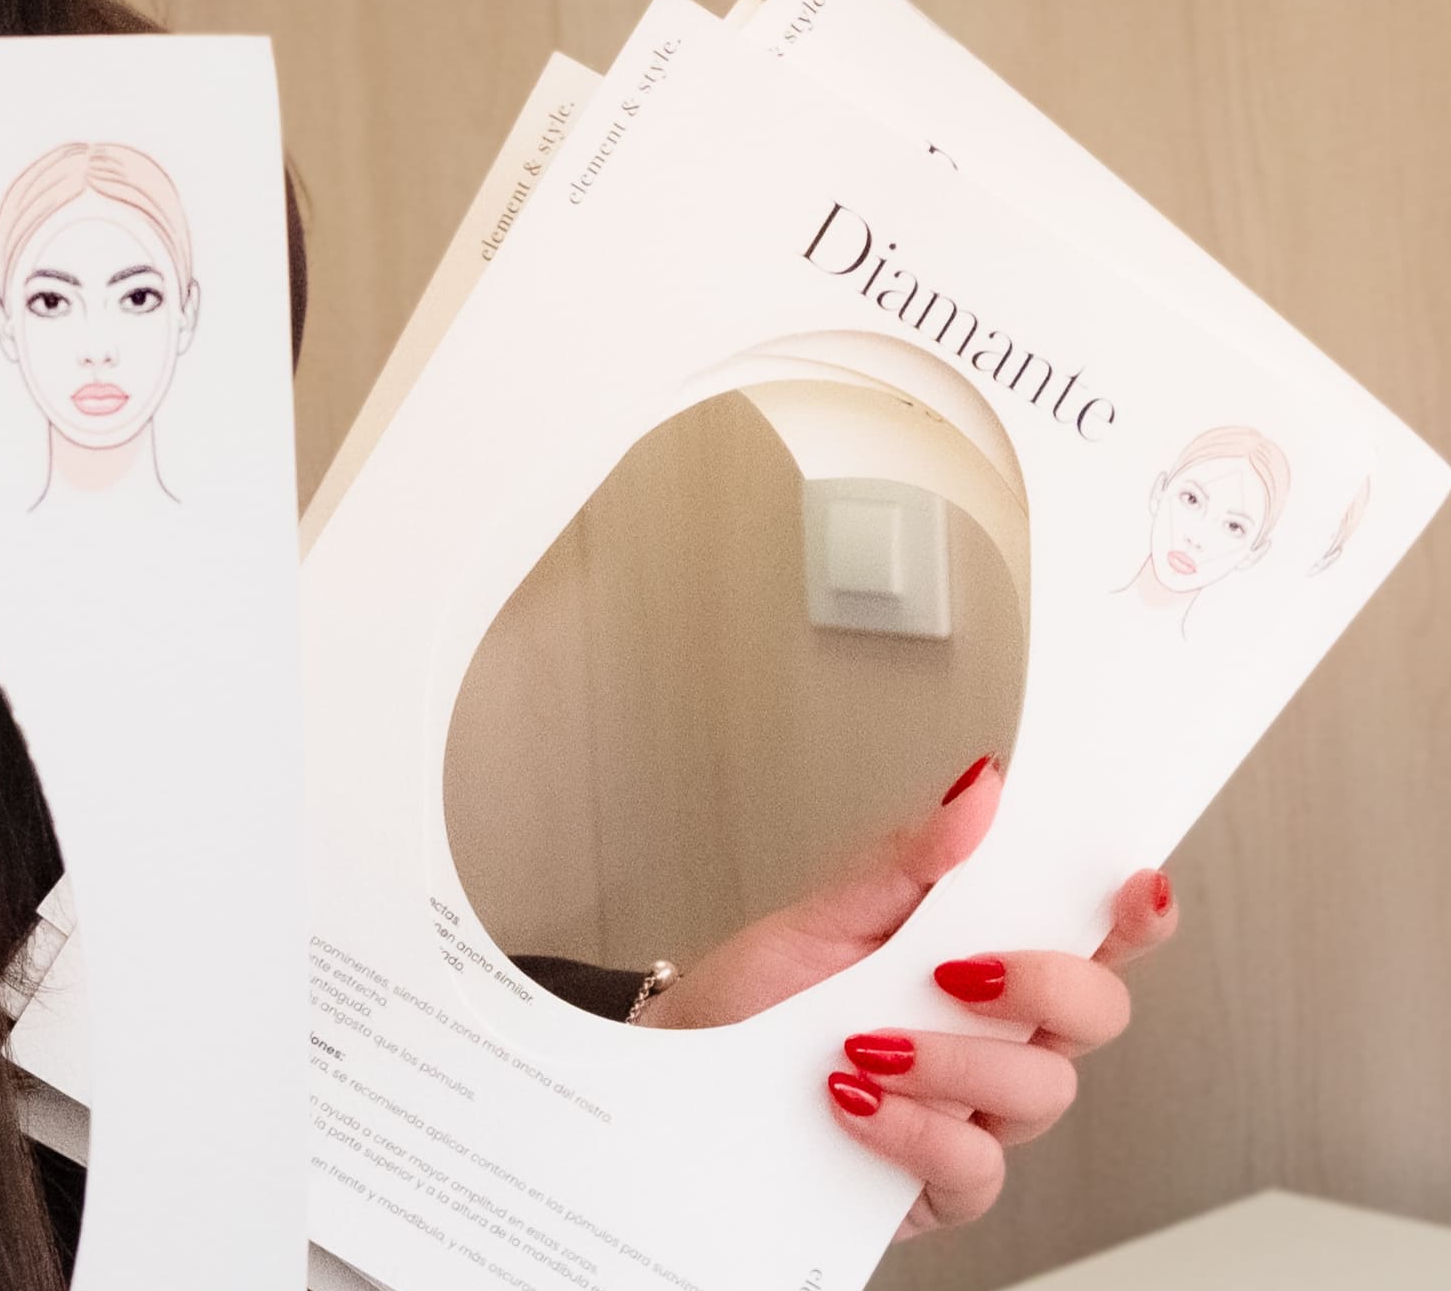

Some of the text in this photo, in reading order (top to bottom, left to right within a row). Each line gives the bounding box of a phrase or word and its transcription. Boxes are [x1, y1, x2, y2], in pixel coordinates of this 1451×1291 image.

[481, 101, 576, 262] element & style.
[568, 38, 682, 205] element & style.
[800, 199, 1116, 443] Diamante
